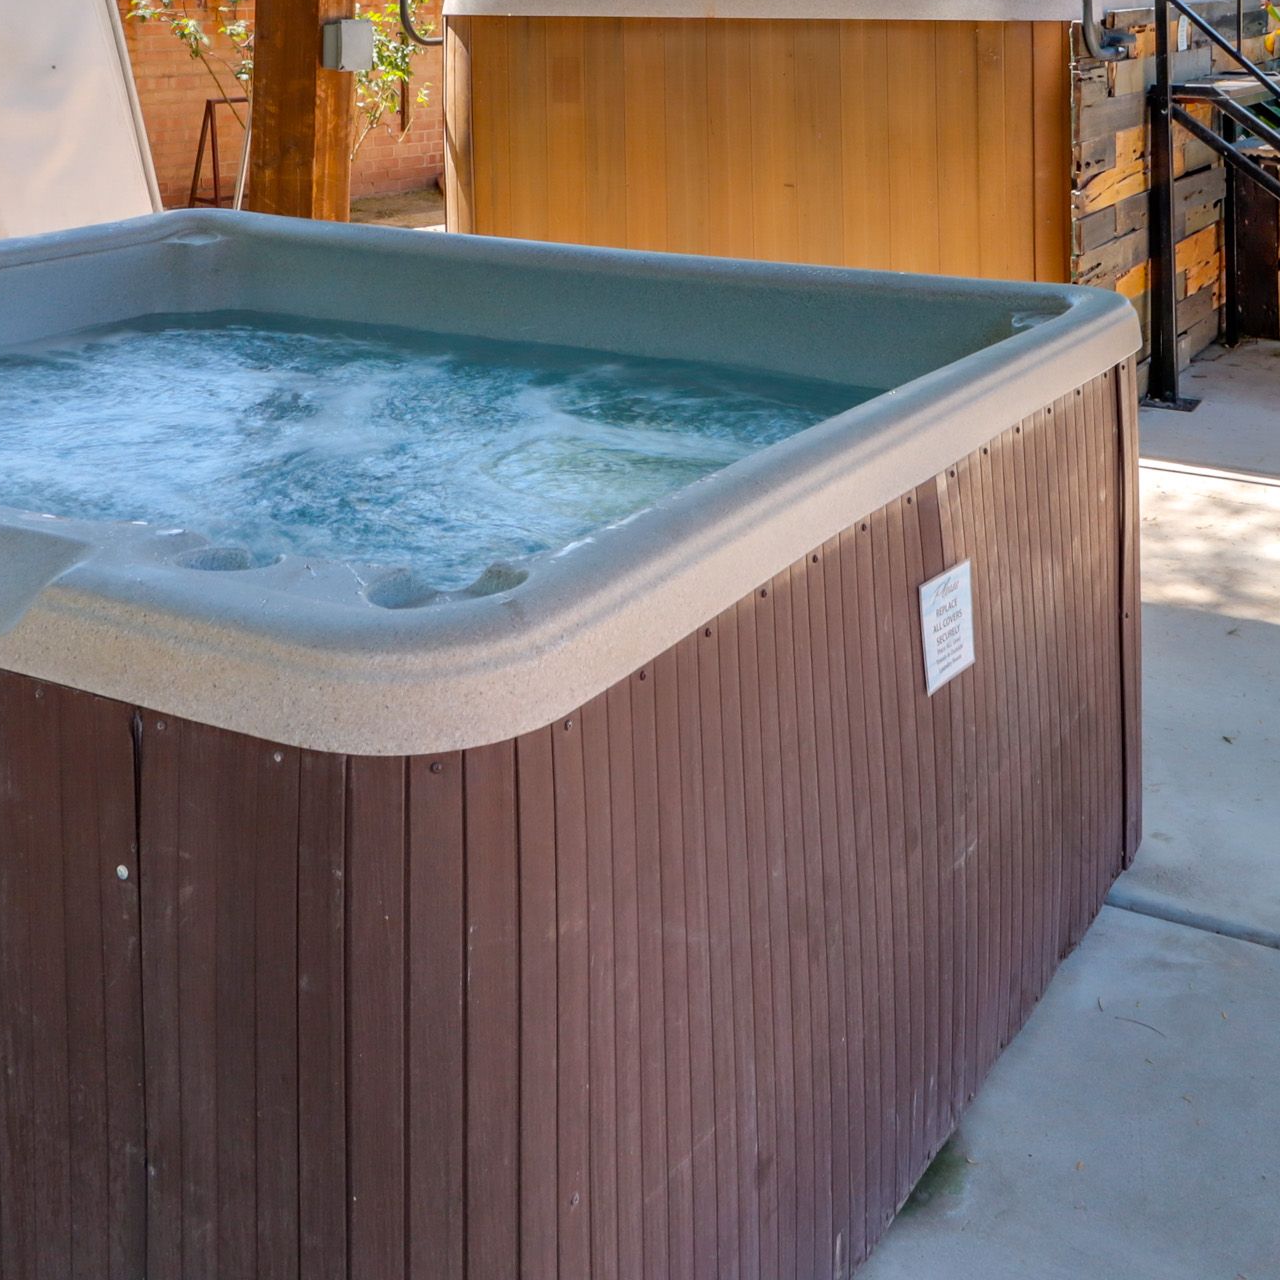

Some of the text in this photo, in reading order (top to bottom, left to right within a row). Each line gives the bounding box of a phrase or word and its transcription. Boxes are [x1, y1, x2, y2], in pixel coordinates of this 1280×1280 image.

[936, 599, 958, 617] REPLACE
[933, 609, 963, 634] ALL COVERS
[936, 624, 961, 646] SECURELY
